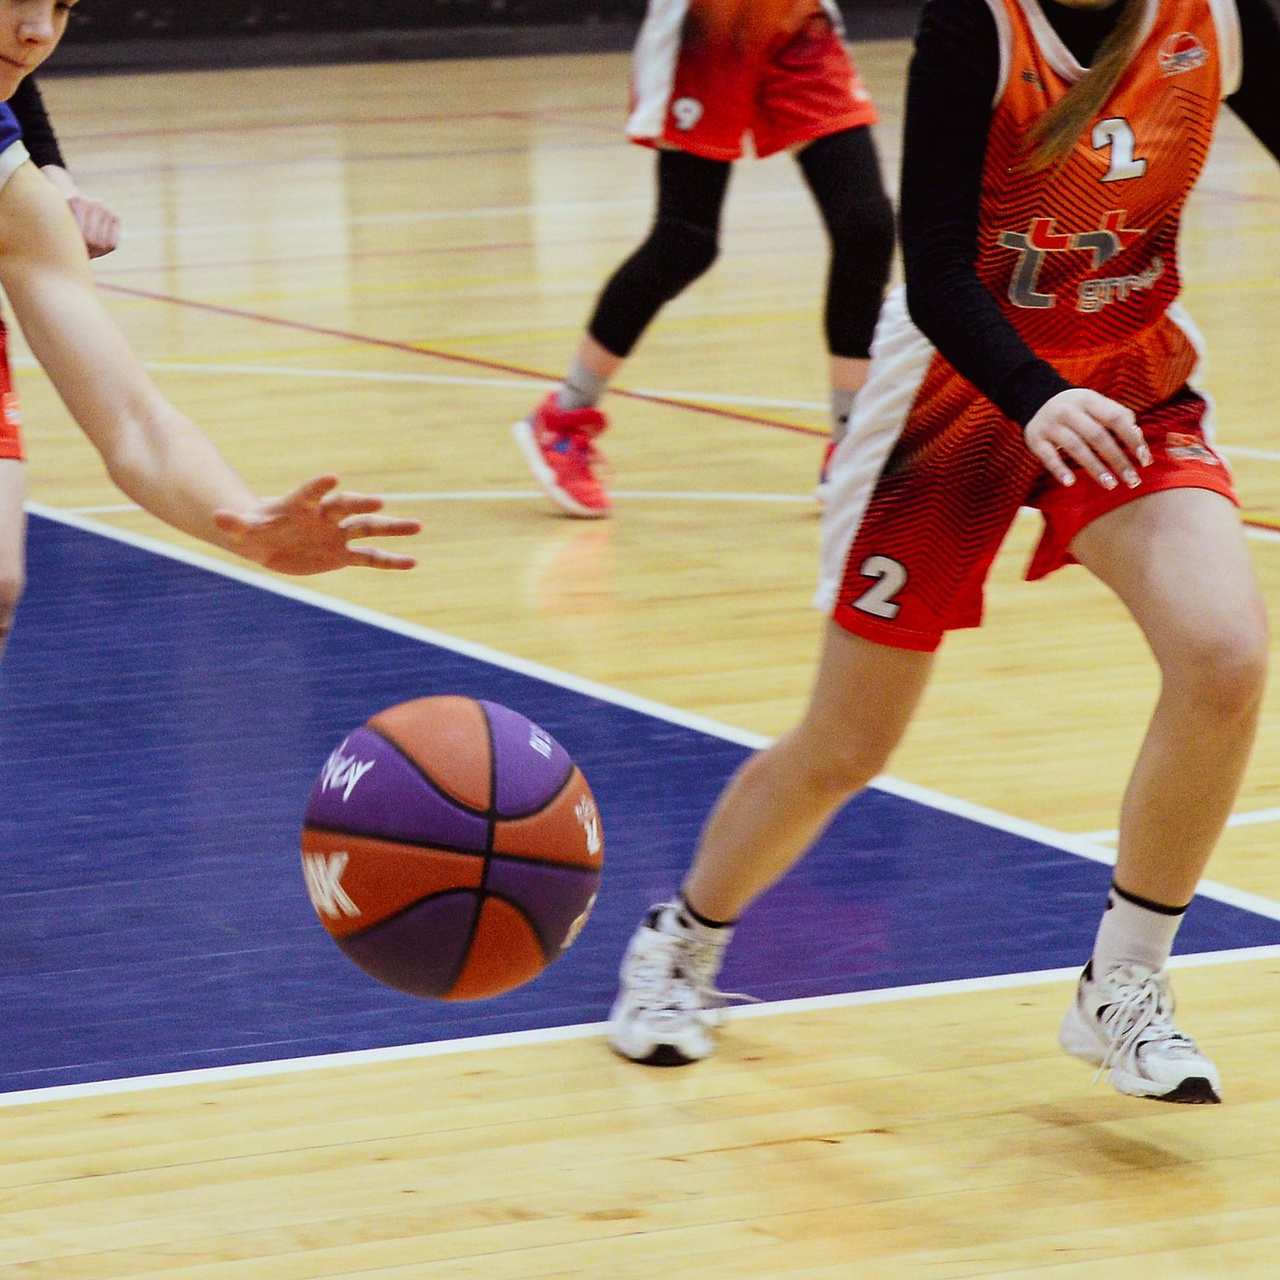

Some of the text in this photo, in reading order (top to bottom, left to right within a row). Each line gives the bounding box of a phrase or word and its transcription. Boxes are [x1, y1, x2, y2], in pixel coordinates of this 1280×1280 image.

[672, 96, 704, 131] 9
[1091, 116, 1147, 183] 2
[851, 553, 908, 620] 2
